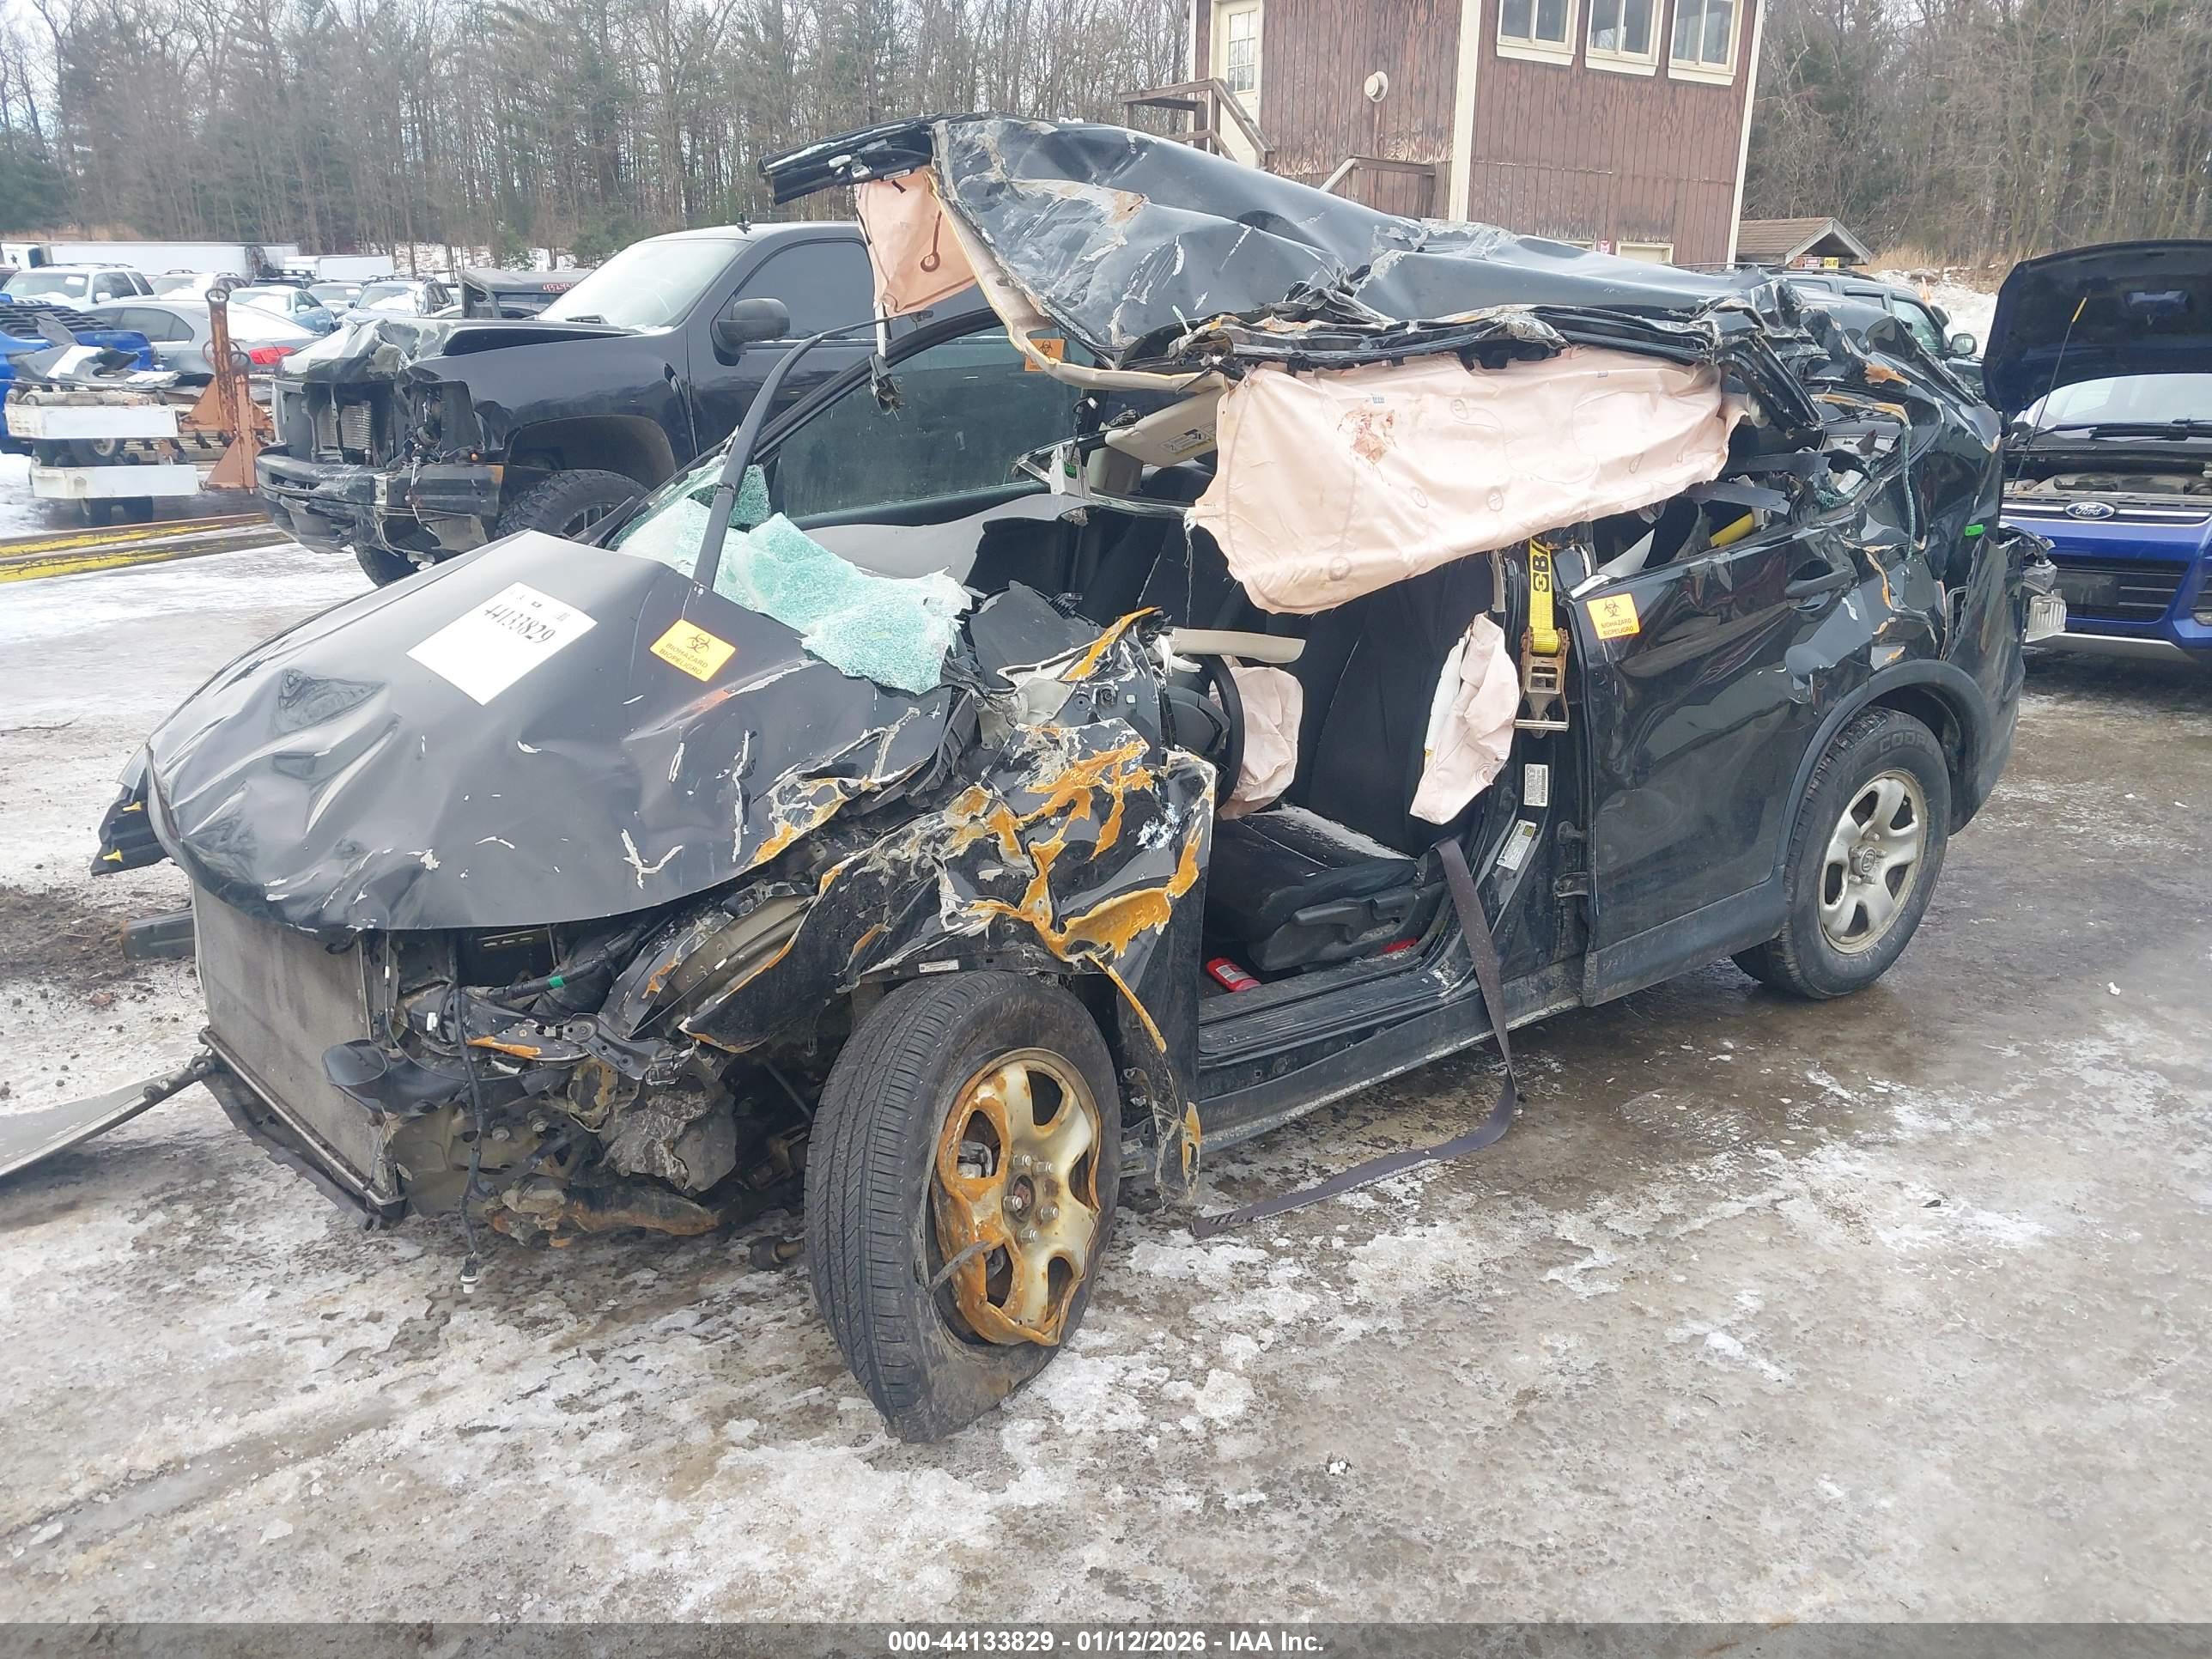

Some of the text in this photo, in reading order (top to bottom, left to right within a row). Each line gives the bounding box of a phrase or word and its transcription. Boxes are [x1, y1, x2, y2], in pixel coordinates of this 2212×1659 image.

[2074, 503, 2103, 516] Ford
[483, 603, 556, 644] 44133829
[1601, 617, 1632, 628] BIOHAZARD
[1602, 626, 1634, 636] BIOPELIGRO
[659, 647, 702, 676] BIOPELIGRO
[665, 641, 708, 669] BIOHAZARD
